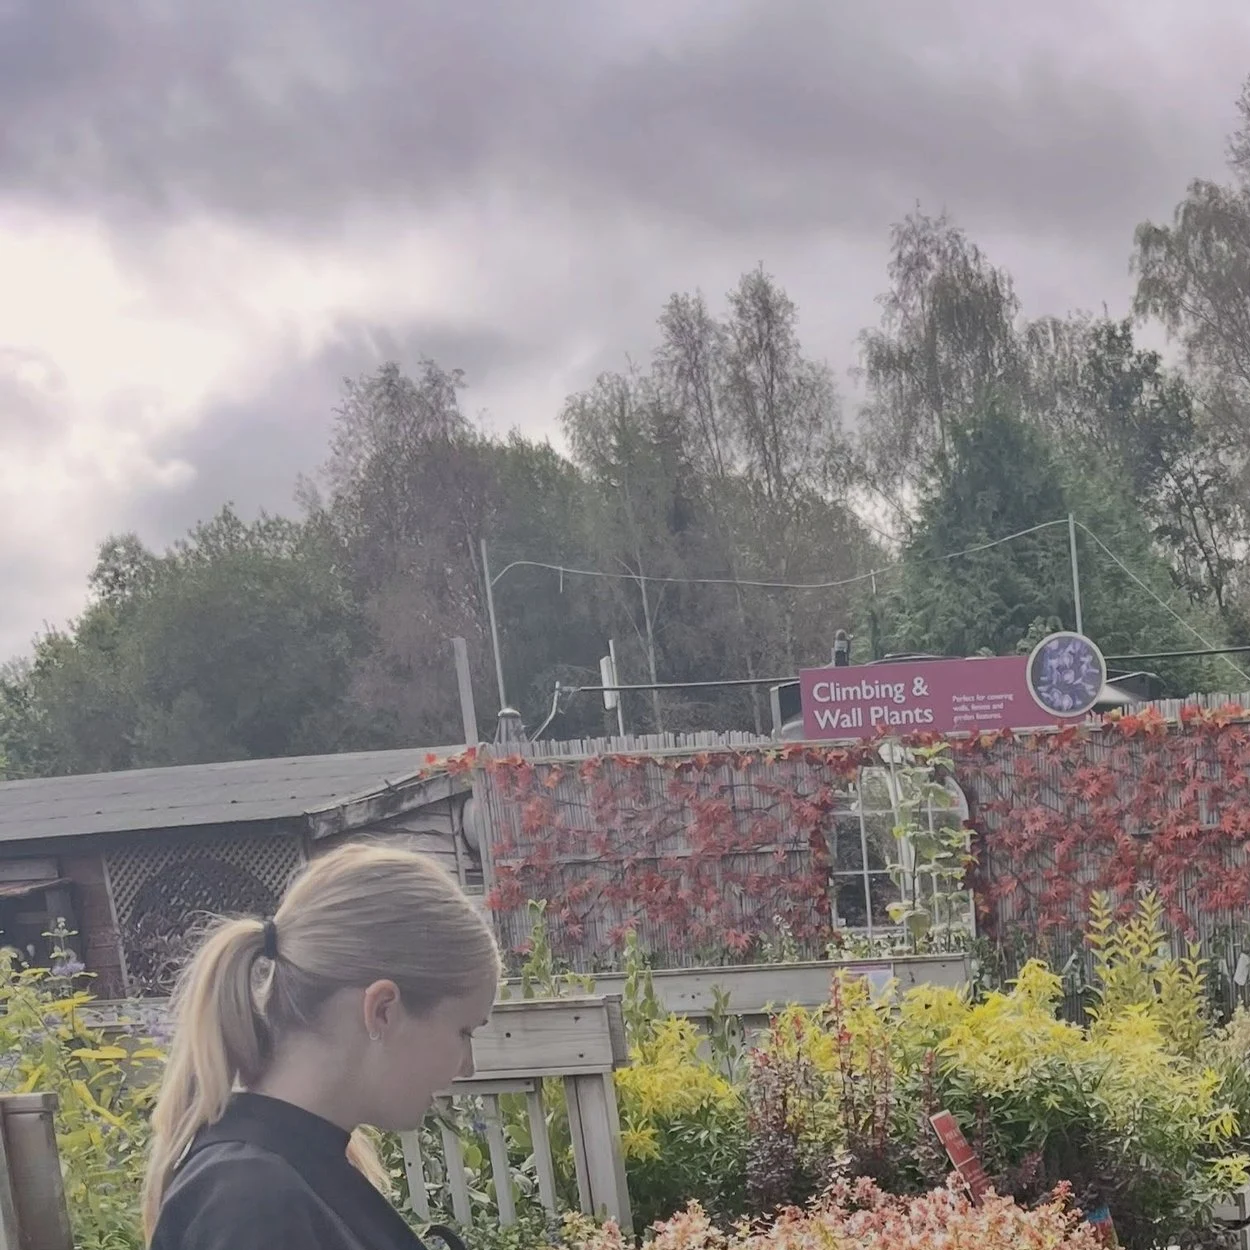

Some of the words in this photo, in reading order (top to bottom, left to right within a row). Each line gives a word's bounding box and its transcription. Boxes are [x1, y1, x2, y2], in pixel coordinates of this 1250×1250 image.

[812, 679, 906, 704] Climbing
[911, 676, 929, 697] &
[813, 707, 863, 730] Wall
[869, 705, 934, 727] Plants
